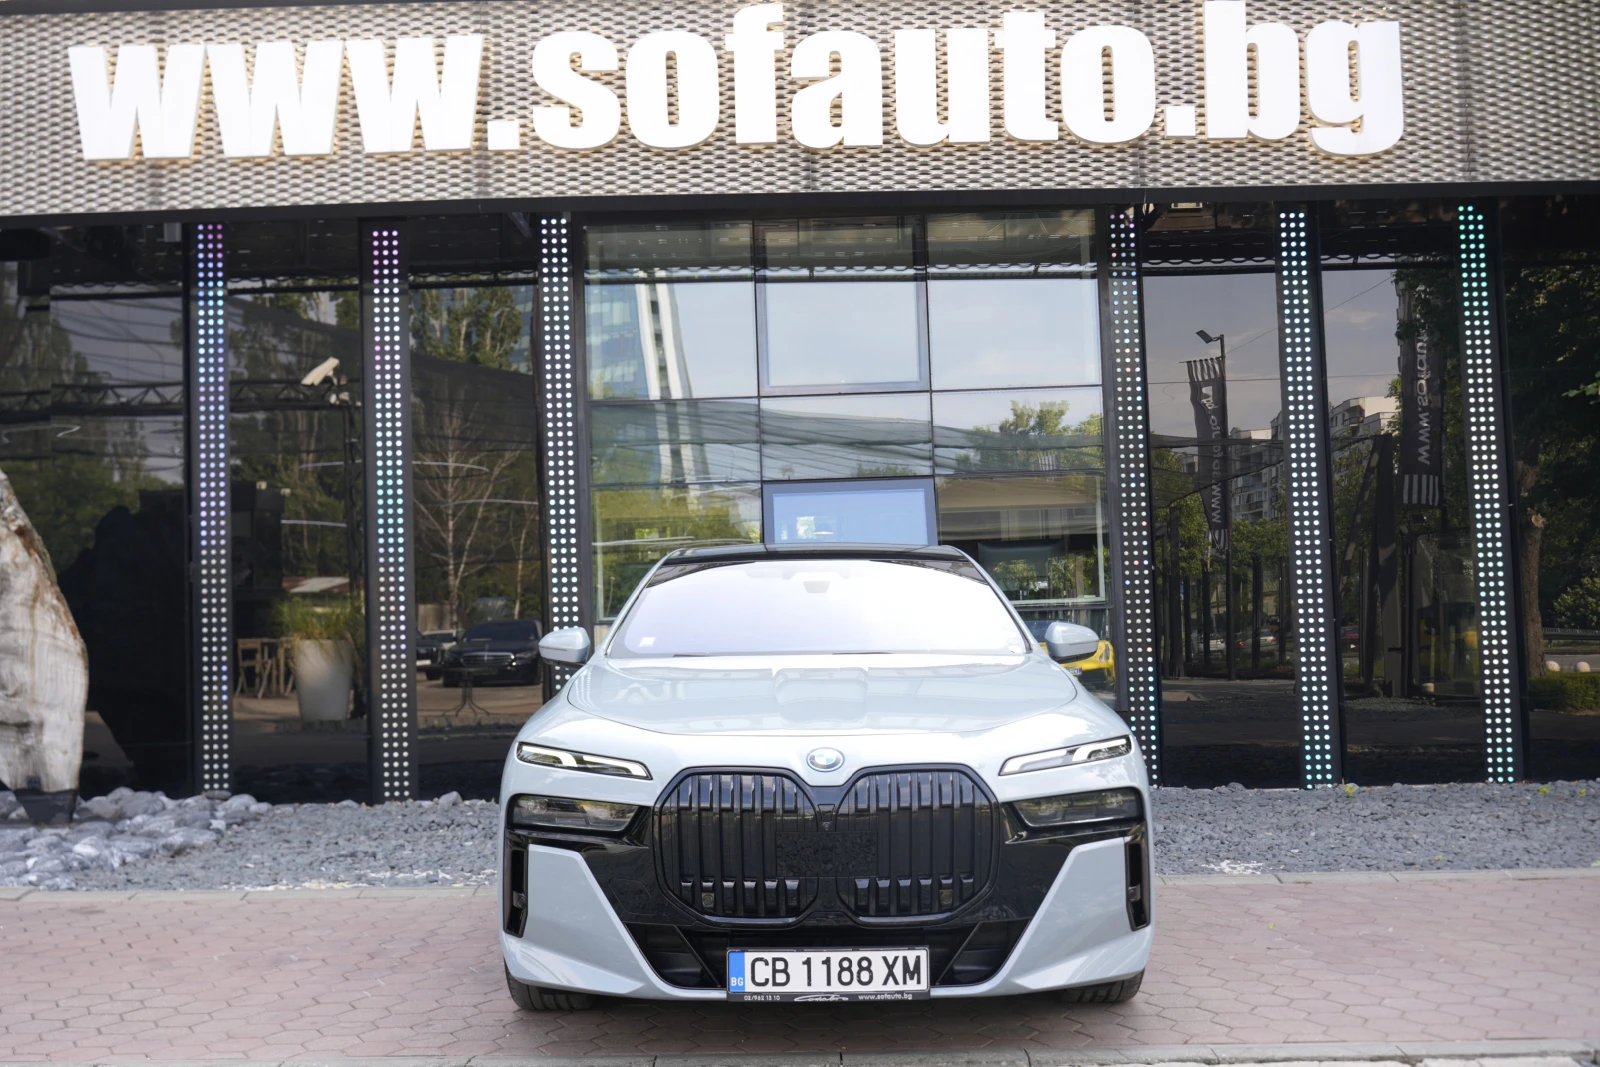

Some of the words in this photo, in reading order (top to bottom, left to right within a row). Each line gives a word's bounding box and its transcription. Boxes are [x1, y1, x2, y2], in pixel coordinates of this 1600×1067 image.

[67, 0, 1404, 161] www.sofauto.bg
[750, 957, 791, 987] CB
[802, 956, 874, 987] 1188
[882, 955, 922, 986] XM
[730, 977, 744, 987] BG
[857, 992, 913, 1001] www.sofauto.bg
